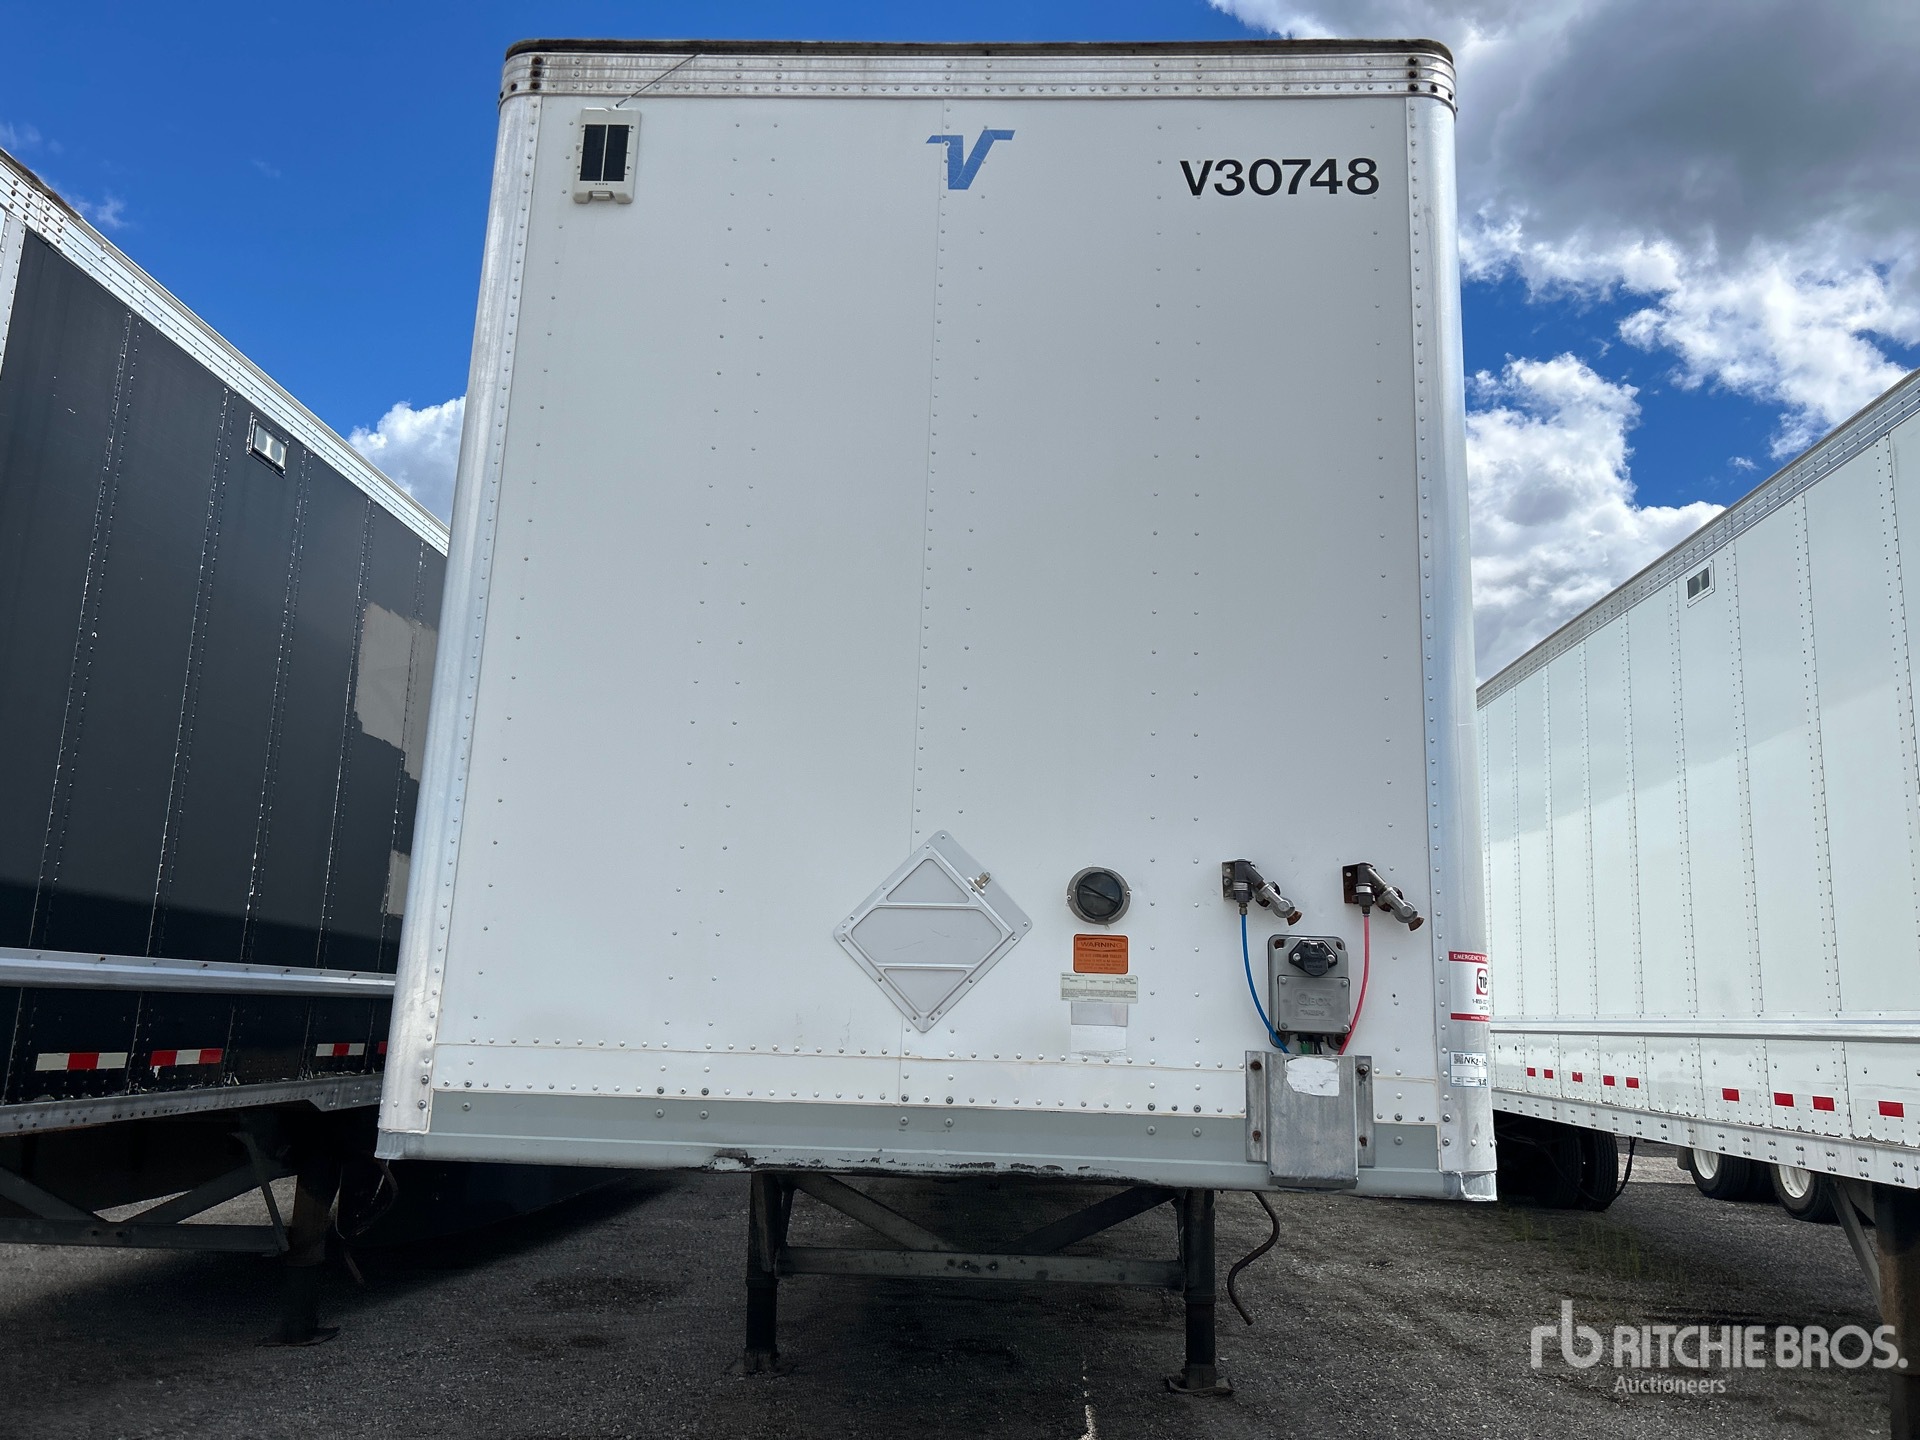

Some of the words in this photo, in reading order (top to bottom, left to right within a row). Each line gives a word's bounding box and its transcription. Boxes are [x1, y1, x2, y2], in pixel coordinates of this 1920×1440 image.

[1180, 157, 1380, 197] V30748
[1080, 941, 1123, 949] WARNING
[1453, 953, 1482, 962] EMERGENCY
